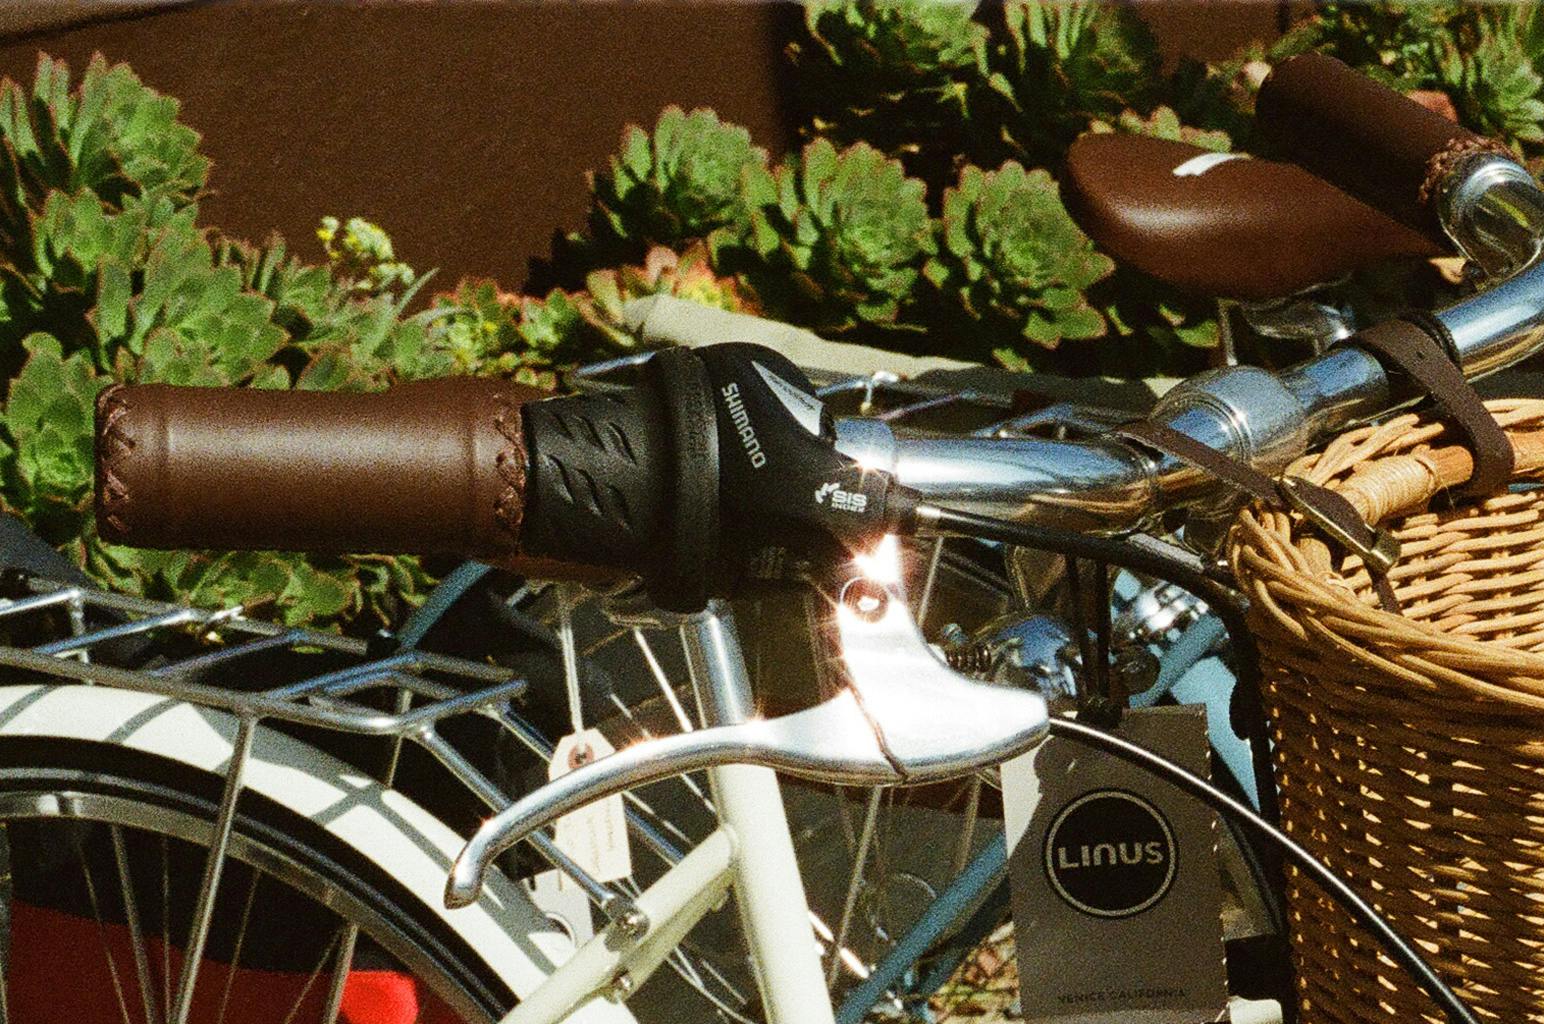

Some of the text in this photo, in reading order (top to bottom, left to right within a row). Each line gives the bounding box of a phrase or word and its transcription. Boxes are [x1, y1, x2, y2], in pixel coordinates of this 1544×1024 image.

[722, 383, 766, 468] SHIMANO
[832, 490, 867, 507] SIS
[1058, 842, 1163, 869] LINUS
